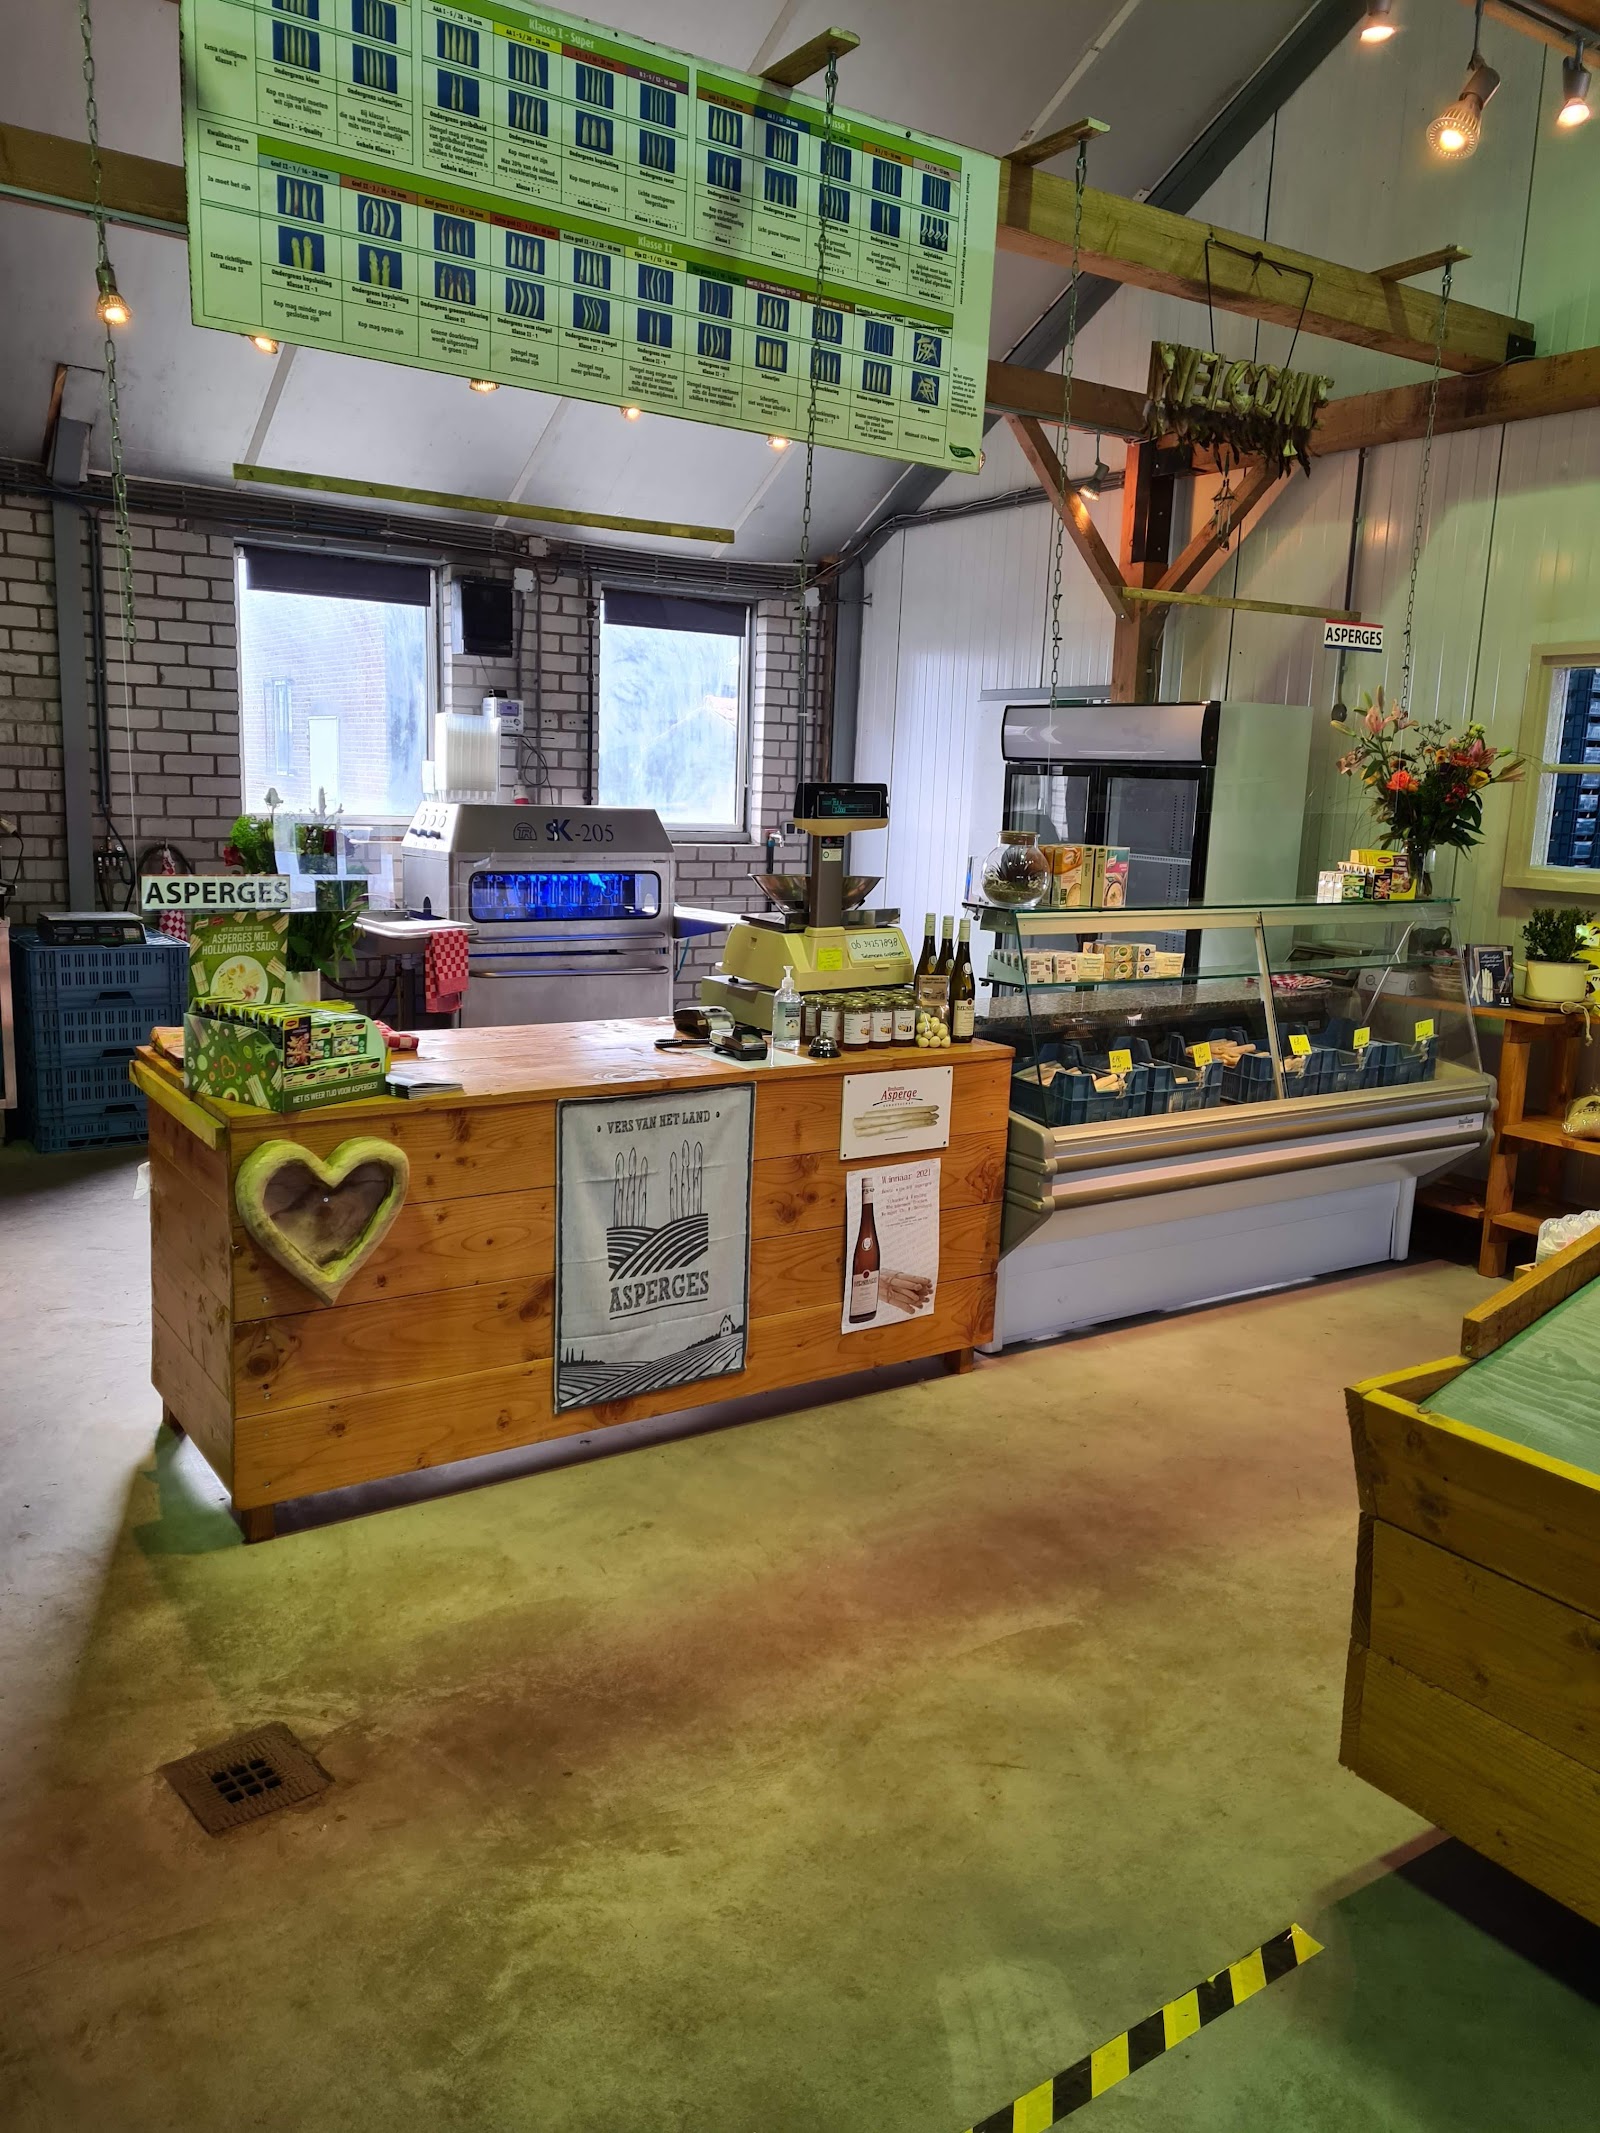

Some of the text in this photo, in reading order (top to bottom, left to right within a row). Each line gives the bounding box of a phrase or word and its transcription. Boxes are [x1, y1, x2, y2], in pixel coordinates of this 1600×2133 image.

[529, 19, 556, 36] Klasse
[558, 28, 562, 38] I
[571, 33, 594, 48] Super
[204, 43, 217, 52] Extra
[274, 67, 319, 84] Ondergrens kleur
[266, 88, 276, 97] Kop
[286, 94, 307, 104] stengel
[308, 100, 328, 109] moeten
[429, 111, 458, 124] Ondergrens
[429, 124, 448, 135] Stengel
[449, 131, 460, 139] mag
[460, 134, 474, 142] enige
[509, 133, 534, 145] Ondergrens
[453, 146, 464, 154] door
[464, 150, 484, 159] normaal
[466, 143, 488, 153] vertonen
[508, 149, 517, 158] Kop
[270, 160, 281, 168] Grof
[569, 174, 578, 183] Kop
[591, 181, 609, 189] gesloten
[638, 236, 673, 254] Klasse II
[210, 252, 252, 265] Extra richtlijnen
[271, 269, 301, 280] Ondergrens
[352, 286, 380, 297] Ondergrens
[273, 300, 284, 309] Kop
[285, 304, 297, 312] mag
[298, 305, 317, 314] minder
[286, 311, 320, 322] gesloten zijn
[358, 321, 367, 329] Kop
[395, 327, 404, 335] zijn
[497, 318, 523, 328] Ondergrens
[536, 325, 553, 333] stengel
[430, 328, 447, 337] Groene
[565, 331, 589, 341] Ondergrens
[601, 338, 617, 347] stengel
[511, 348, 528, 357] Stengel
[637, 347, 660, 356] Ondergrens
[510, 355, 530, 364] gekromd
[578, 361, 593, 370] Stengel
[583, 369, 602, 377] gekromd
[629, 366, 644, 374] Stengel
[1325, 626, 1382, 646] ASPERGES
[145, 881, 289, 904] ASPERGES
[212, 931, 270, 944] ASPERGES MET
[202, 941, 278, 955] HOLLANDAISE SAUS!
[851, 940, 861, 949] 06
[293, 1095, 303, 1103] HET
[311, 1091, 325, 1100] WEER
[327, 1089, 336, 1097] TIJD
[352, 1082, 378, 1092] ASPERGES!
[881, 1089, 917, 1102] Asperge
[606, 1110, 710, 1134] VERS VAN HET LAND
[882, 1169, 930, 1184] Winnaar 2021
[609, 1270, 710, 1314] ASPERGES
